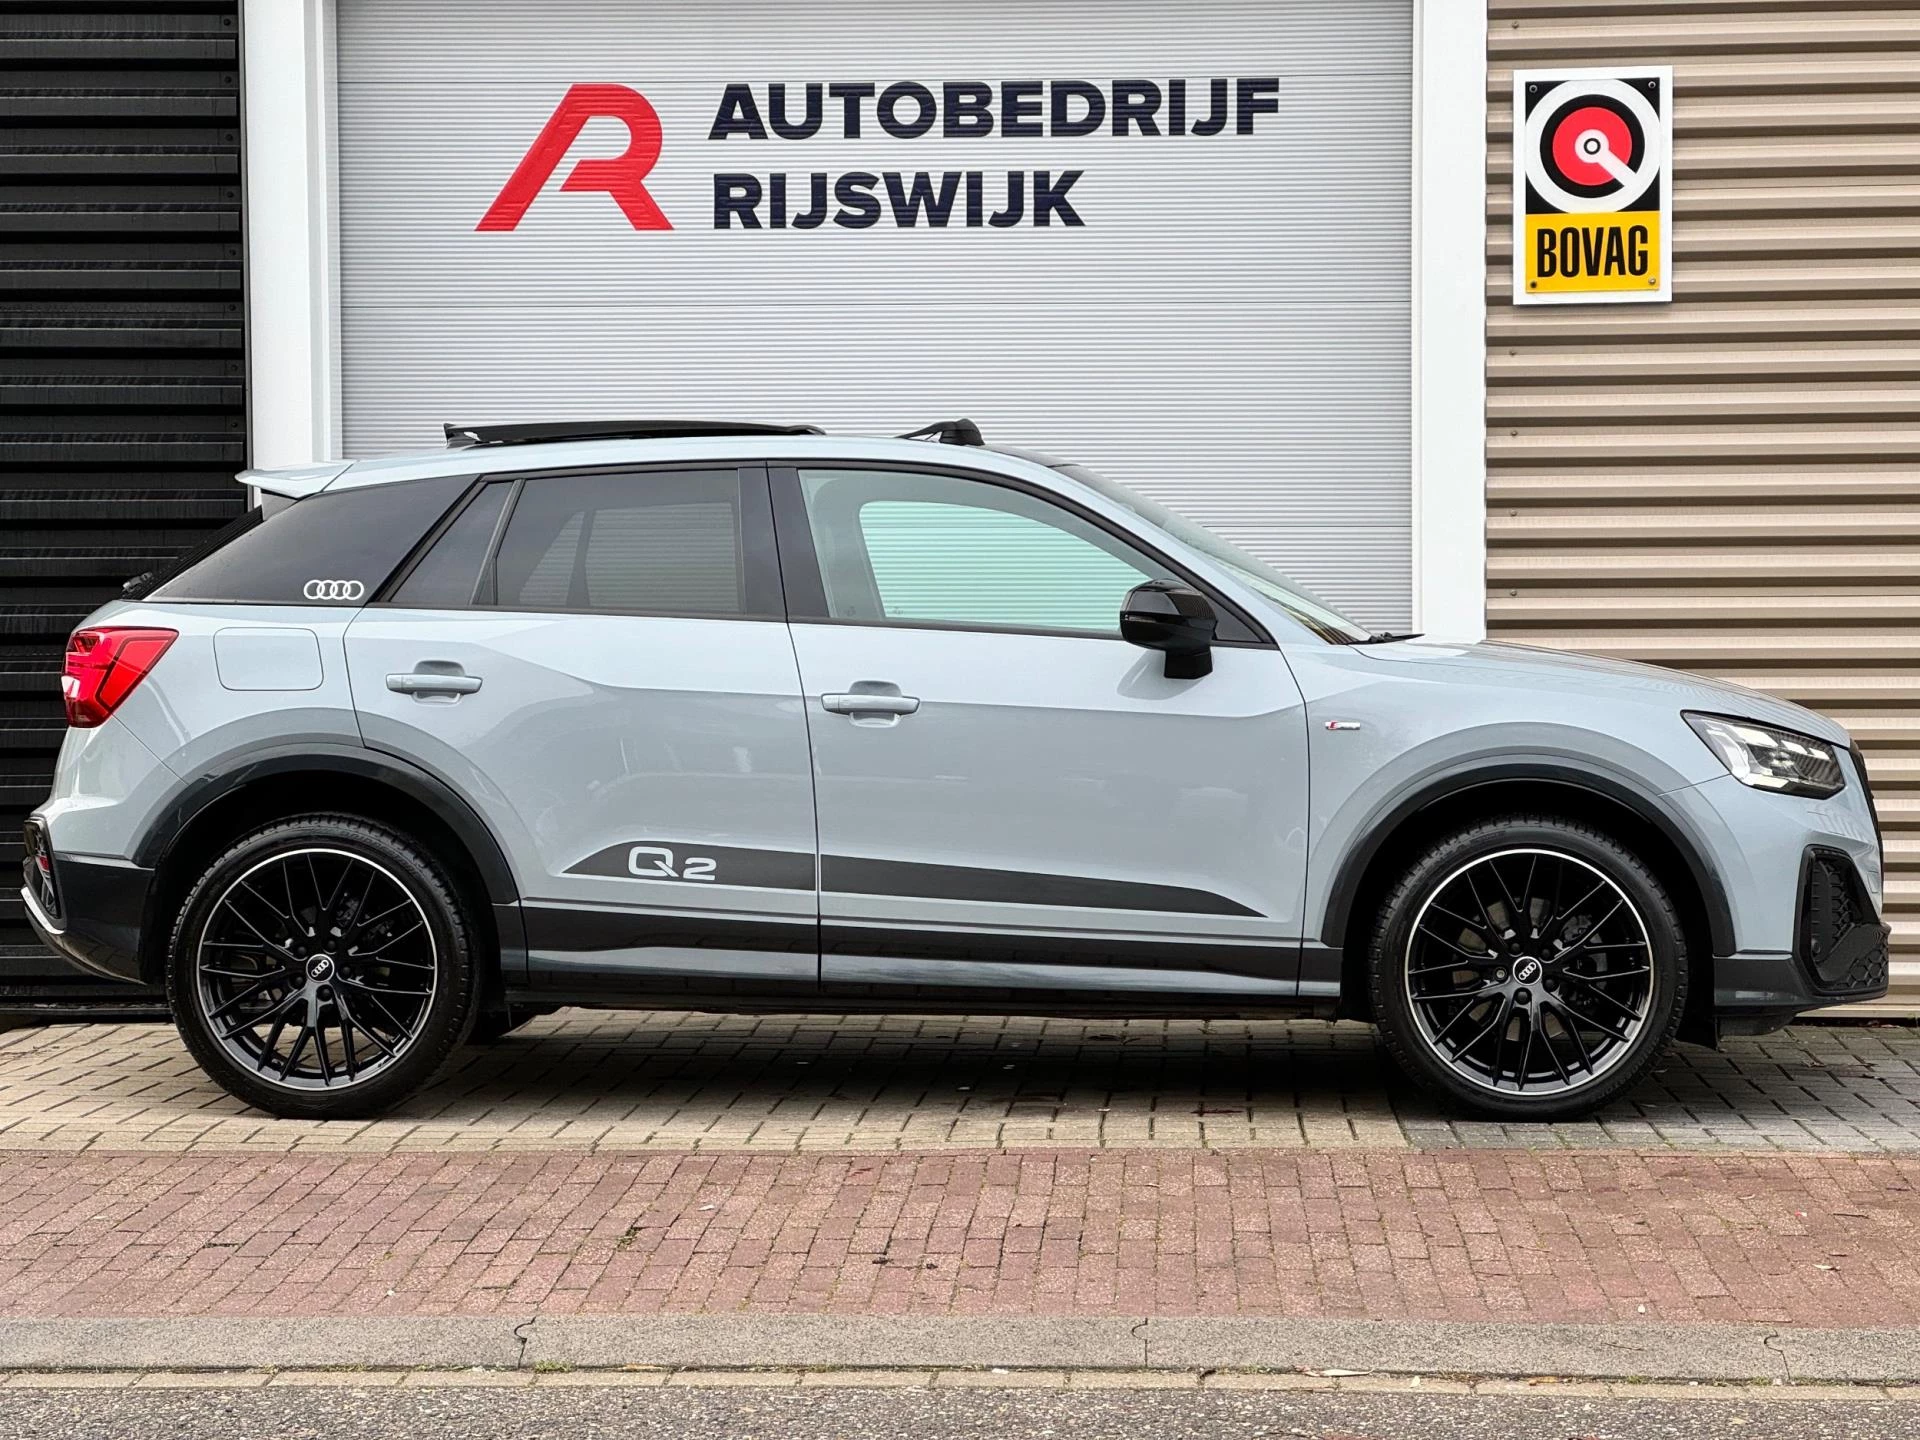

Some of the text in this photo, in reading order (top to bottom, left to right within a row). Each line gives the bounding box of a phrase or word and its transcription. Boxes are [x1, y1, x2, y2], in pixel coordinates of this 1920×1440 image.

[708, 77, 1280, 140] AUTOBEDRIJF
[713, 170, 1085, 230] RIJSWIJK
[1536, 224, 1649, 278] BOVAG
[627, 845, 718, 881] Q2
